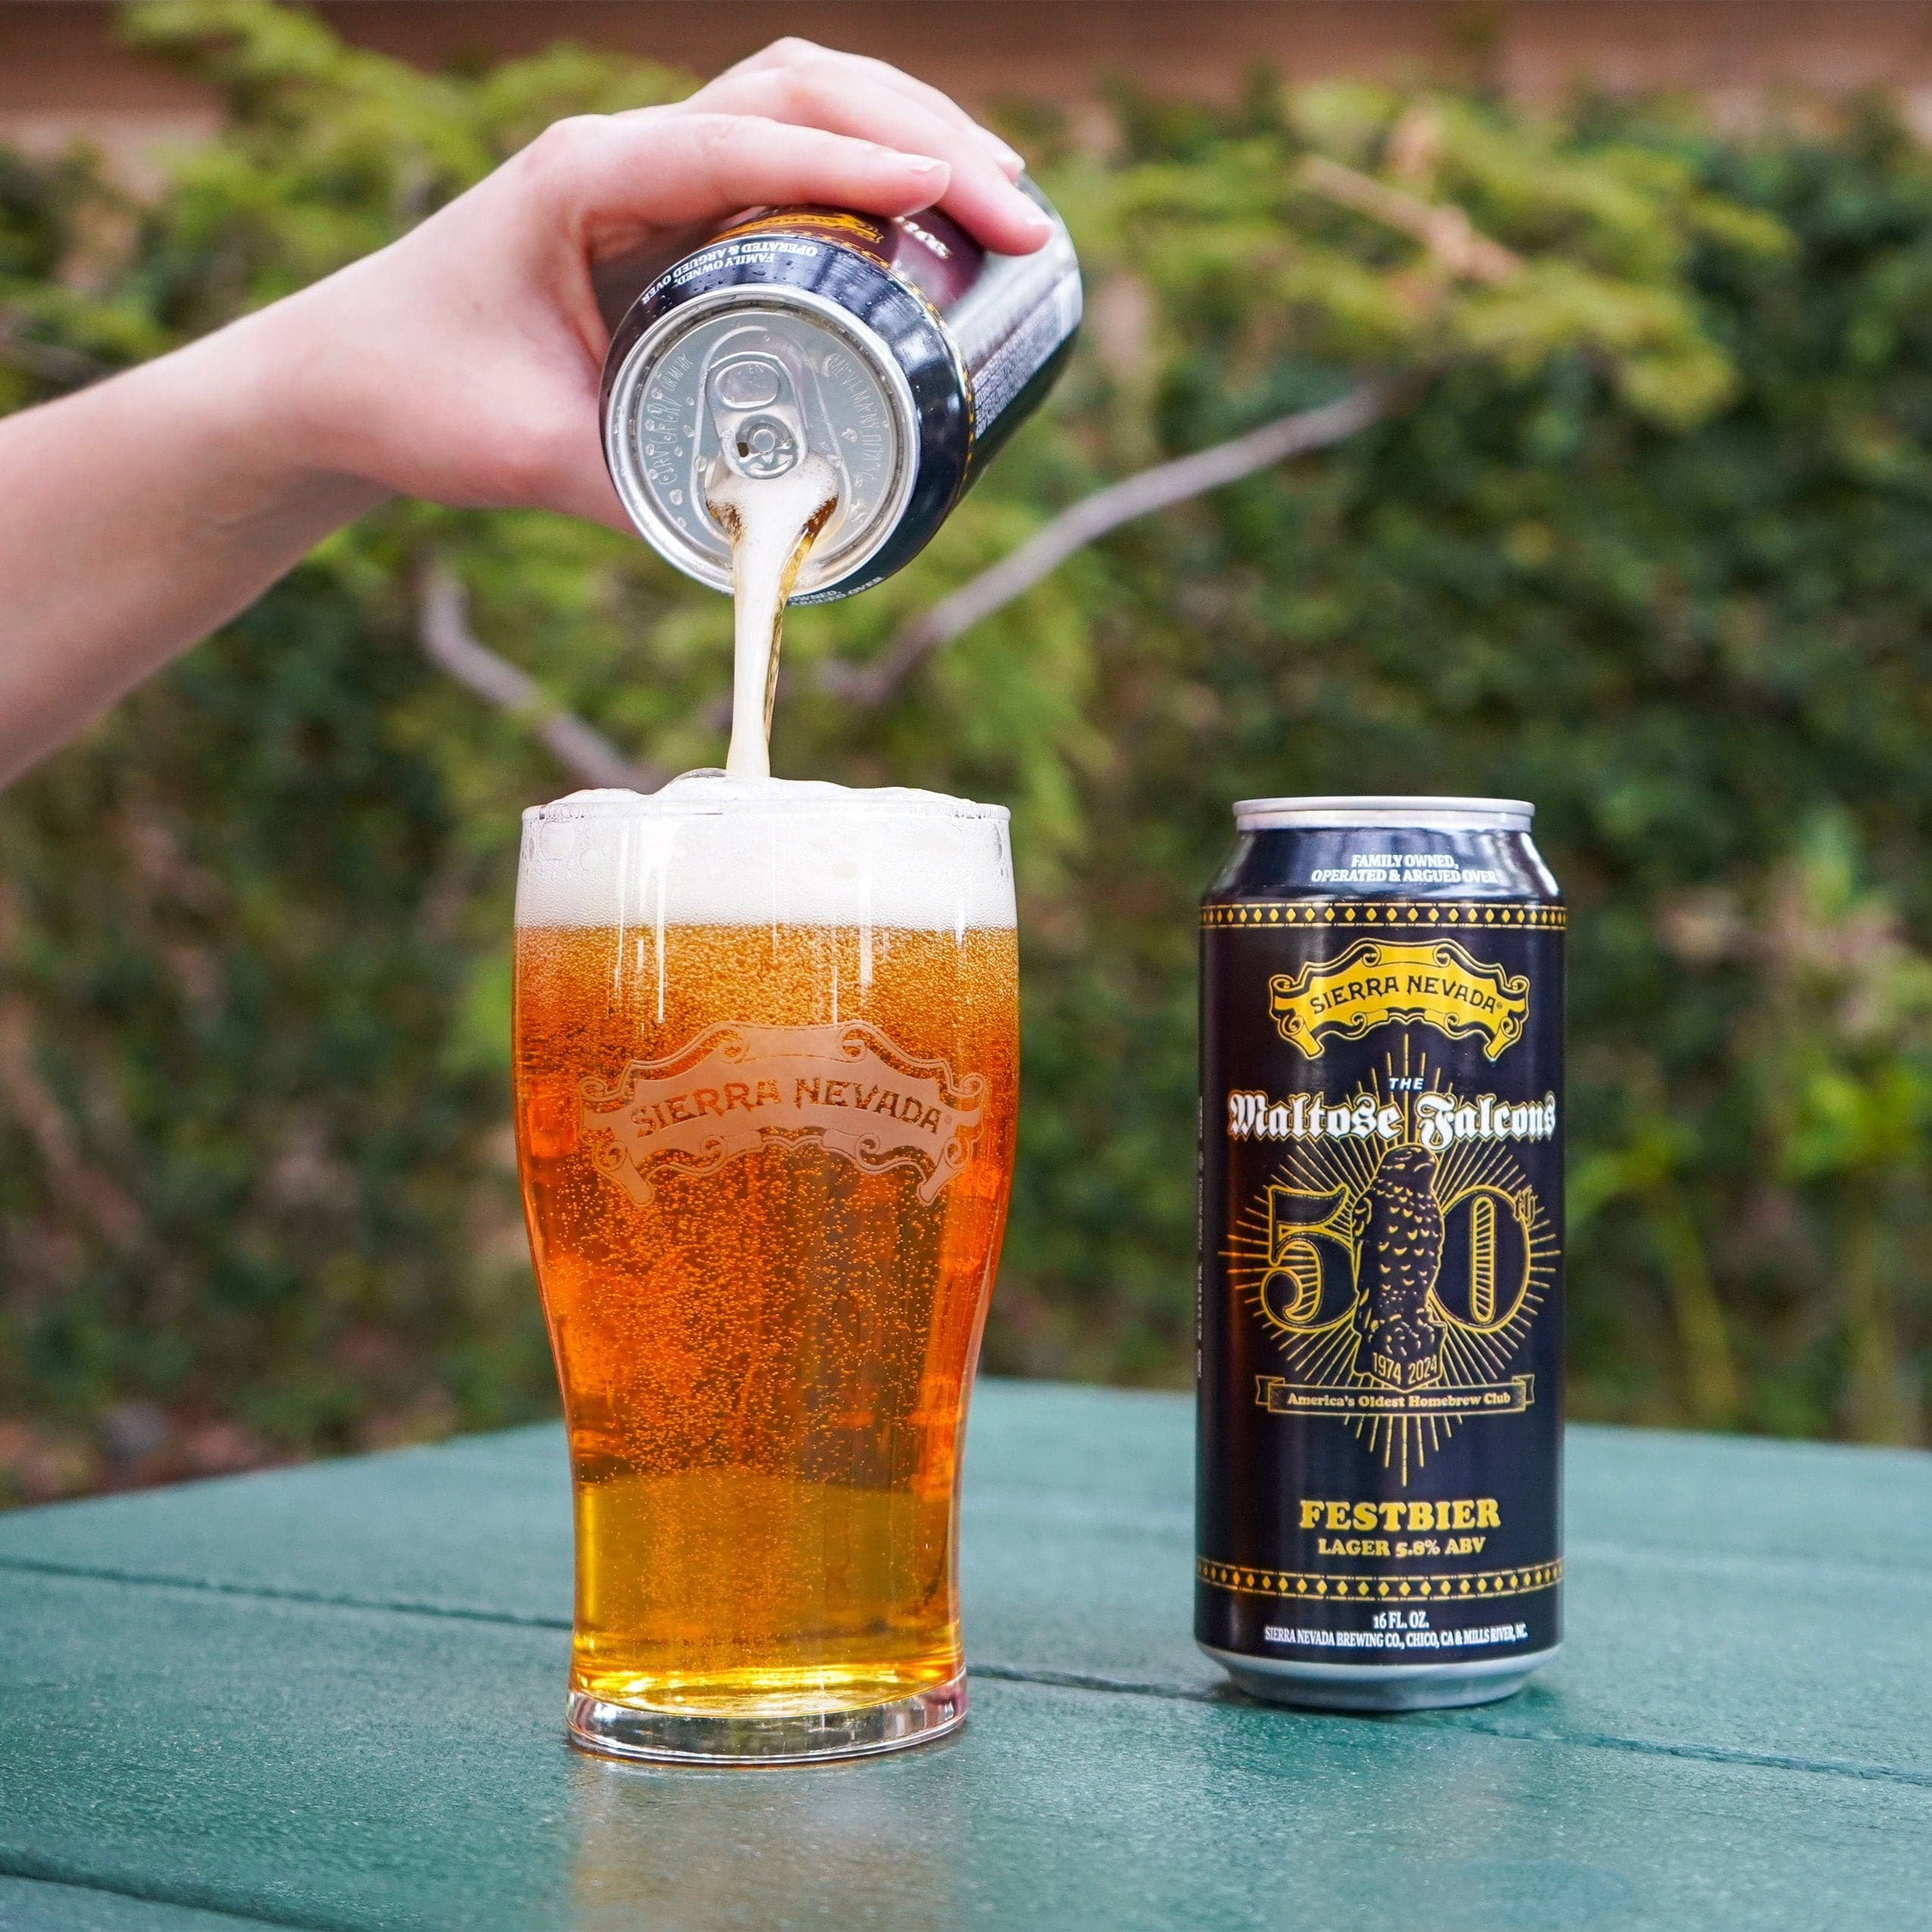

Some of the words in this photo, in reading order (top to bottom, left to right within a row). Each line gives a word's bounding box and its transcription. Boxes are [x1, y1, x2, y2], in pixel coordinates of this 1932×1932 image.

[724, 252, 776, 268] FAMILY
[741, 241, 818, 257] OPERATED
[673, 247, 727, 278] ARGUED
[641, 275, 672, 305] OVER
[1351, 854, 1402, 868] FAMILY
[1404, 854, 1459, 870] OWNED,
[1311, 869, 1388, 882] OPERATED
[1389, 870, 1401, 882] &
[1402, 869, 1461, 883] ARGUED
[1462, 870, 1499, 883] OVER
[1310, 976, 1400, 1014] SIERRA
[1389, 1077, 1424, 1090] THE
[630, 1078, 781, 1136] SIERRA
[793, 1074, 943, 1134] NEVADA
[1228, 1091, 1405, 1140] Maltose
[1416, 1090, 1557, 1152] Falcons
[1372, 1352, 1402, 1385] 1974
[1408, 1353, 1438, 1385] 2024
[1287, 1392, 1355, 1407] America's
[1358, 1395, 1405, 1408] Oldest
[1408, 1394, 1481, 1408] Homebrew
[1483, 1391, 1512, 1405] Club
[1299, 1498, 1502, 1532] FESTBIER
[1318, 1537, 1391, 1557] LAGER
[1395, 1539, 1441, 1558] 5.8%
[1445, 1536, 1487, 1555] ABV
[1373, 1614, 1387, 1629] 16
[1388, 1611, 1408, 1629] FL.
[1408, 1610, 1430, 1629] OZ.
[1265, 1626, 1296, 1643] SIERRA
[1296, 1629, 1335, 1646] NEVADA
[1336, 1633, 1384, 1647] BREWING
[1405, 1632, 1440, 1649] CHICO,
[1440, 1631, 1454, 1646] CA
[1454, 1630, 1463, 1646] &
[1463, 1628, 1490, 1646] MILLS
